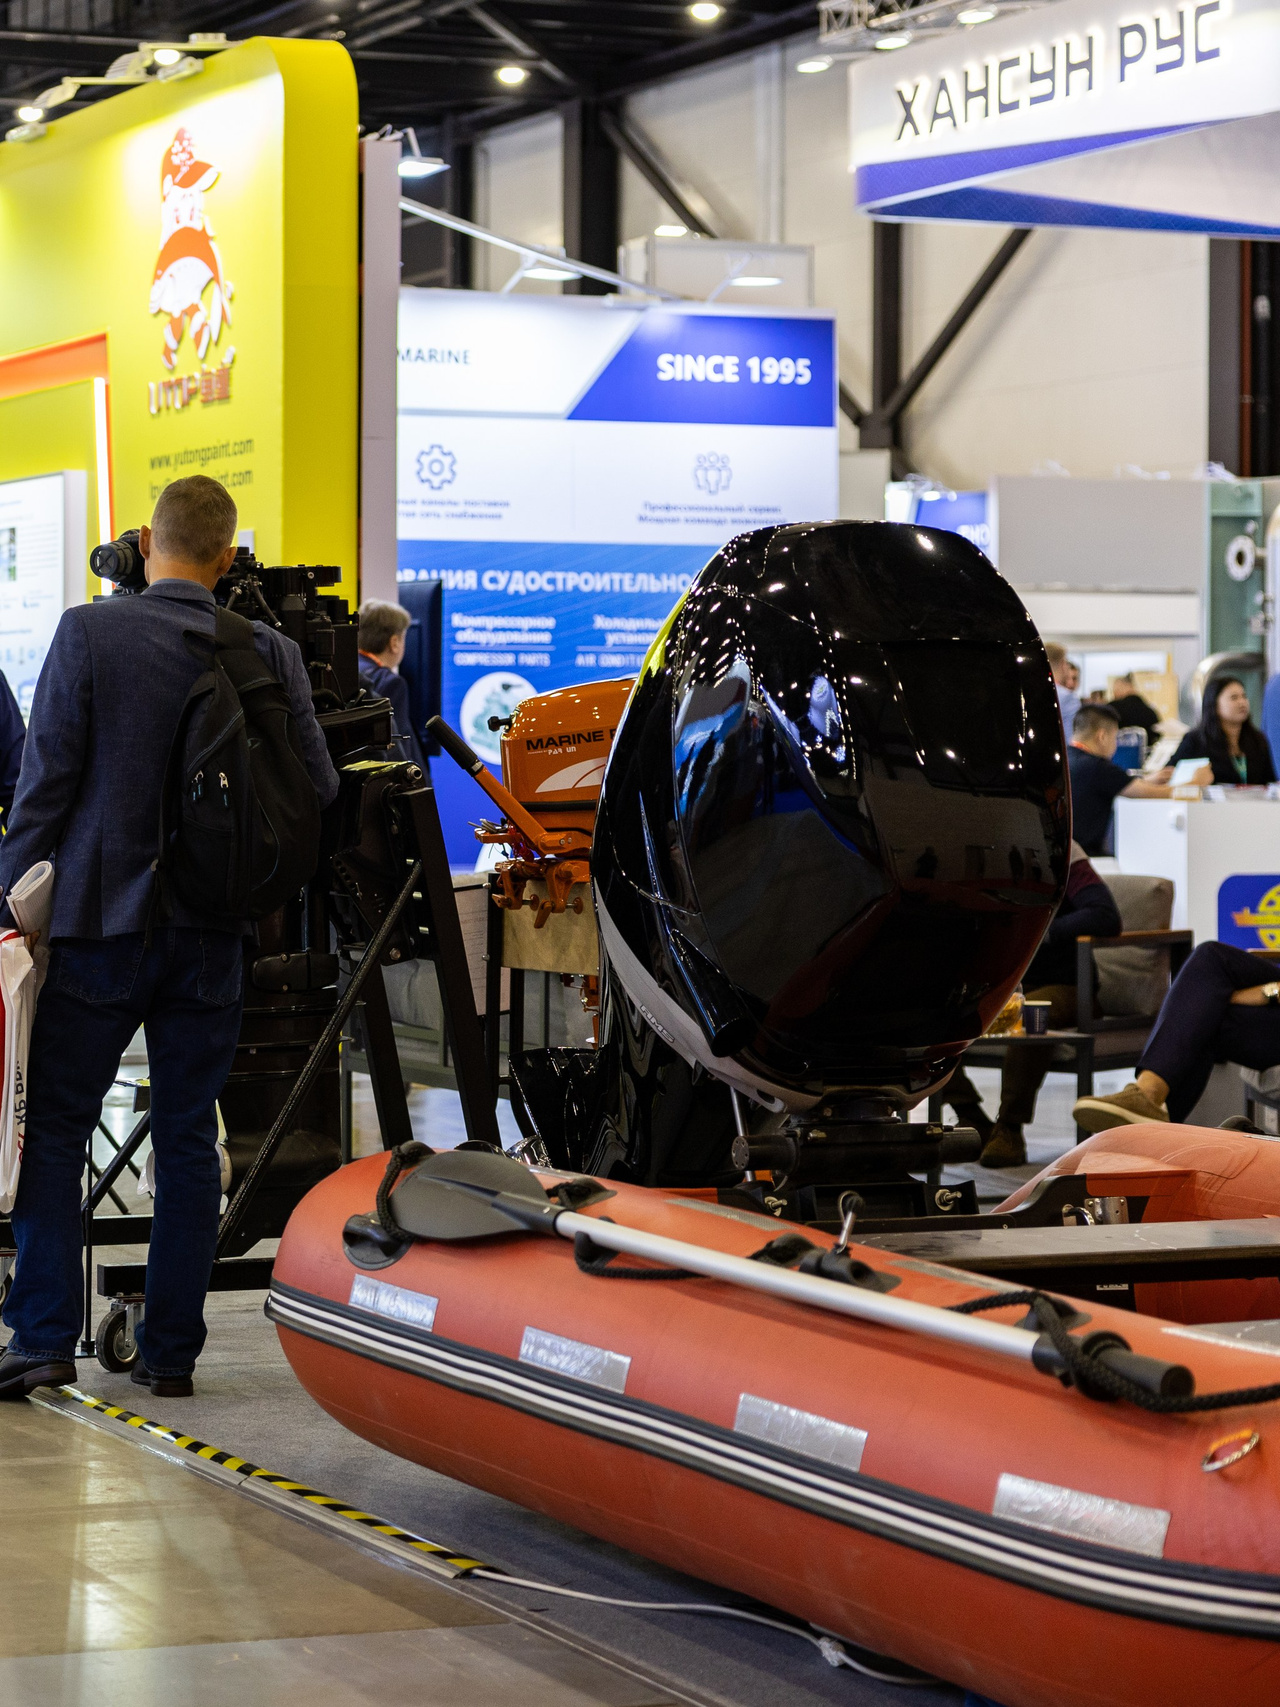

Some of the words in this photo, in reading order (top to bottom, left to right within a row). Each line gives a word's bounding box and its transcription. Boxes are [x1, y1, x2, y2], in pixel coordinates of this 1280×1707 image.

[896, 35, 1094, 141] ХАНСУН
[1118, 0, 1221, 83] РУС
[399, 347, 470, 365] MARINE
[656, 353, 740, 383] SINCE
[746, 356, 812, 385] 1995
[526, 730, 604, 751] MARINE
